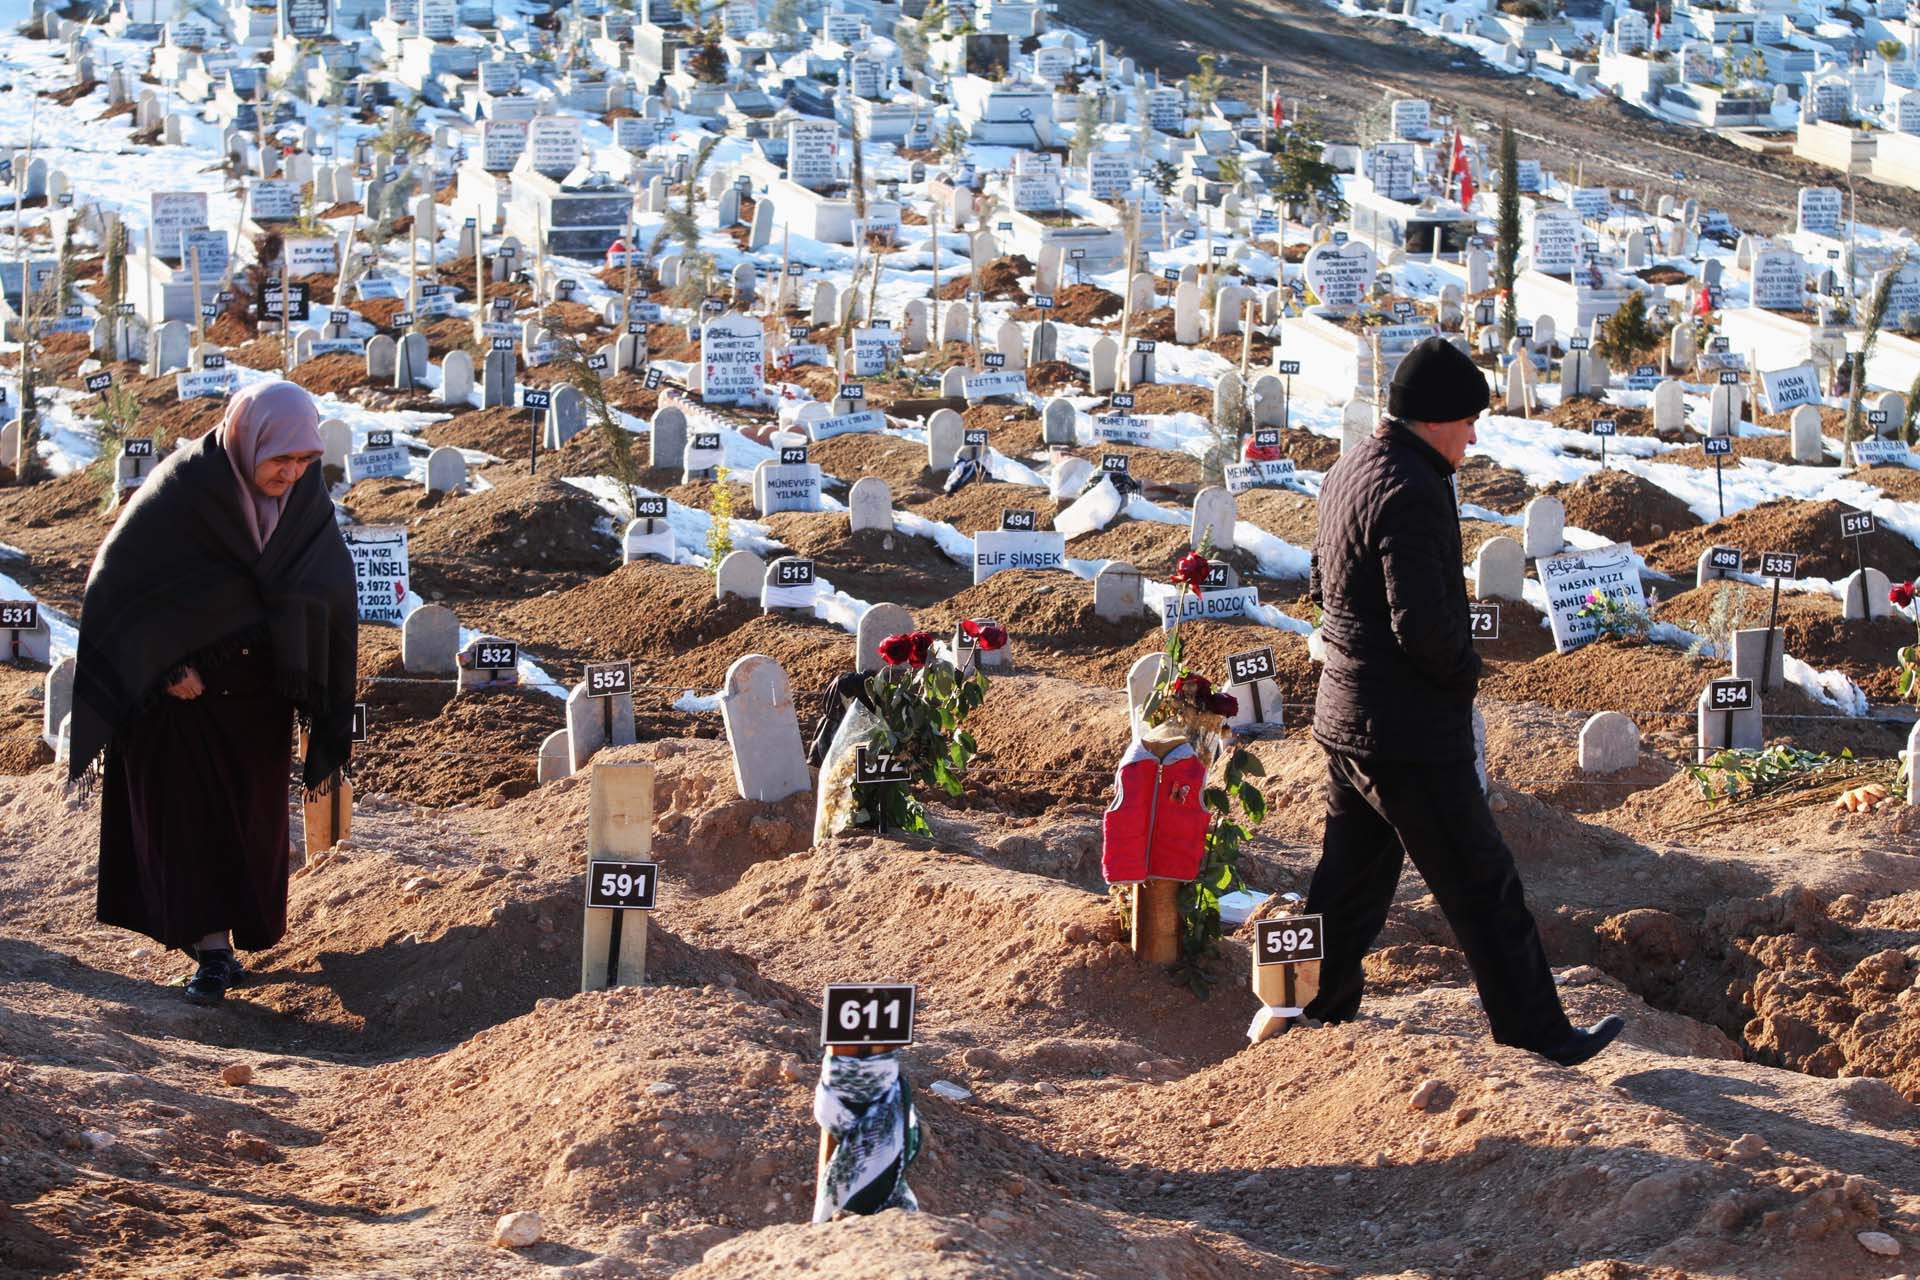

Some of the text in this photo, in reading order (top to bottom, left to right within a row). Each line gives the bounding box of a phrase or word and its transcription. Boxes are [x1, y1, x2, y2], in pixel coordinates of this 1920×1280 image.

[792, 327, 807, 337] 377
[494, 339, 512, 348] 414
[204, 356, 223, 367] 413
[706, 349, 762, 365] HANIM ÇİÇEK
[985, 355, 1003, 365] 416
[1281, 363, 1299, 373] 417
[90, 376, 112, 390] 452
[647, 369, 661, 388] 415
[1721, 372, 1737, 382] 418
[1777, 375, 1805, 390] HASAN
[843, 387, 862, 397] 435
[1778, 386, 1810, 404] AKBAY
[526, 393, 548, 405] 472
[1113, 396, 1131, 405] 436
[1097, 415, 1125, 427] MEHMET
[1595, 423, 1613, 433] 457
[369, 434, 391, 445] 453
[697, 436, 718, 447] 454
[966, 433, 984, 443] 455
[1257, 432, 1277, 443] 456
[129, 442, 150, 455] 471
[1707, 439, 1729, 450] 476
[783, 449, 805, 460] 473
[1104, 457, 1125, 468] 474
[767, 477, 817, 490] MÜNEVVER
[775, 489, 809, 500] YILMAZ
[640, 501, 664, 514] 493
[1006, 514, 1030, 526] 494
[1846, 516, 1870, 530] 516
[370, 548, 391, 558] KIZI
[977, 549, 1062, 568] ELİF ŞİMŞEK
[1713, 552, 1738, 565] 496
[368, 559, 406, 577] İNSEL
[1765, 558, 1793, 573] 535
[782, 566, 808, 580] 513
[357, 580, 390, 592] 9.1972
[1558, 571, 1625, 593] HASAN KIZI
[358, 594, 391, 606] 1.2023
[1552, 583, 1639, 612] ŞAHİD İNGÖL
[364, 607, 403, 620] FATİHA
[1166, 597, 1205, 619] ZÜLFÜ
[2, 607, 32, 624] 531
[1468, 612, 1493, 632] 73
[482, 648, 512, 663] 532
[1235, 656, 1269, 677] 553
[593, 670, 627, 689] 552
[1716, 686, 1748, 703] 554
[600, 873, 646, 897] 591
[1266, 927, 1315, 954] 592
[839, 999, 900, 1030] 611
